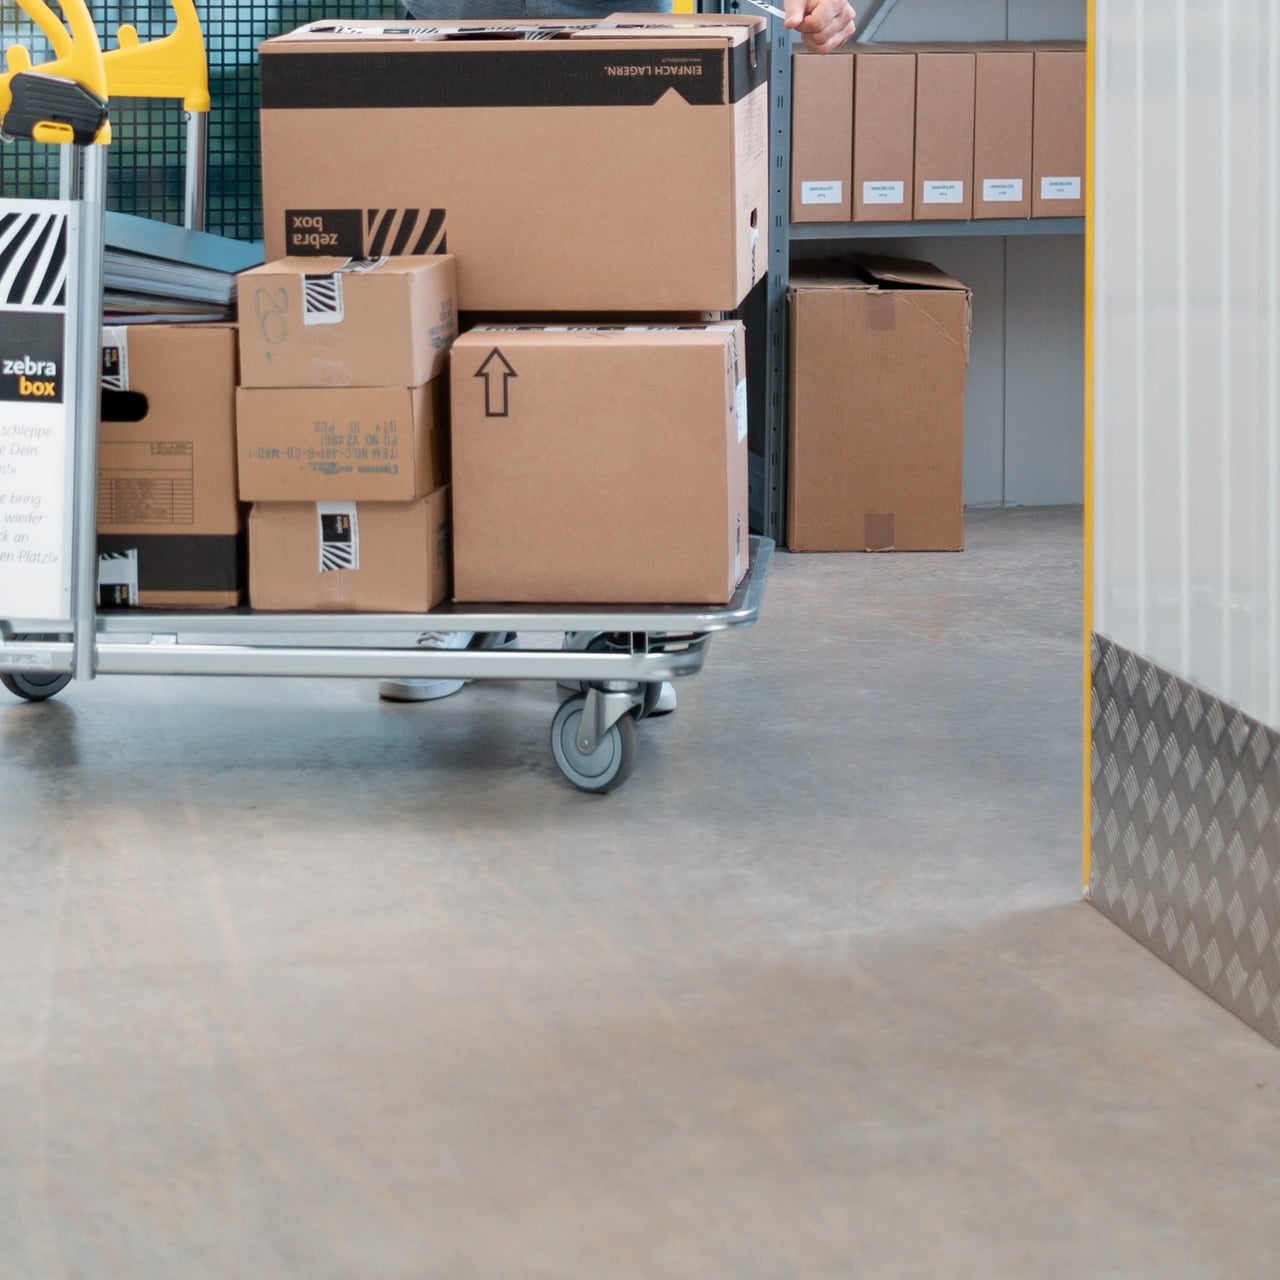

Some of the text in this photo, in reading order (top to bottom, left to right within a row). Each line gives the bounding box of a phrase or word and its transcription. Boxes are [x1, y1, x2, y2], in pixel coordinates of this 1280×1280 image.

[604, 65, 703, 76] EINFACH LAGERN.
[293, 216, 323, 232] box
[293, 233, 339, 250] zebra
[2, 355, 57, 376] zebra
[19, 375, 56, 396] box
[1, 424, 53, 440] schleppe
[10, 443, 38, 457] Dein
[10, 491, 42, 508] bring
[4, 511, 44, 525] wieder
[14, 532, 29, 544] an
